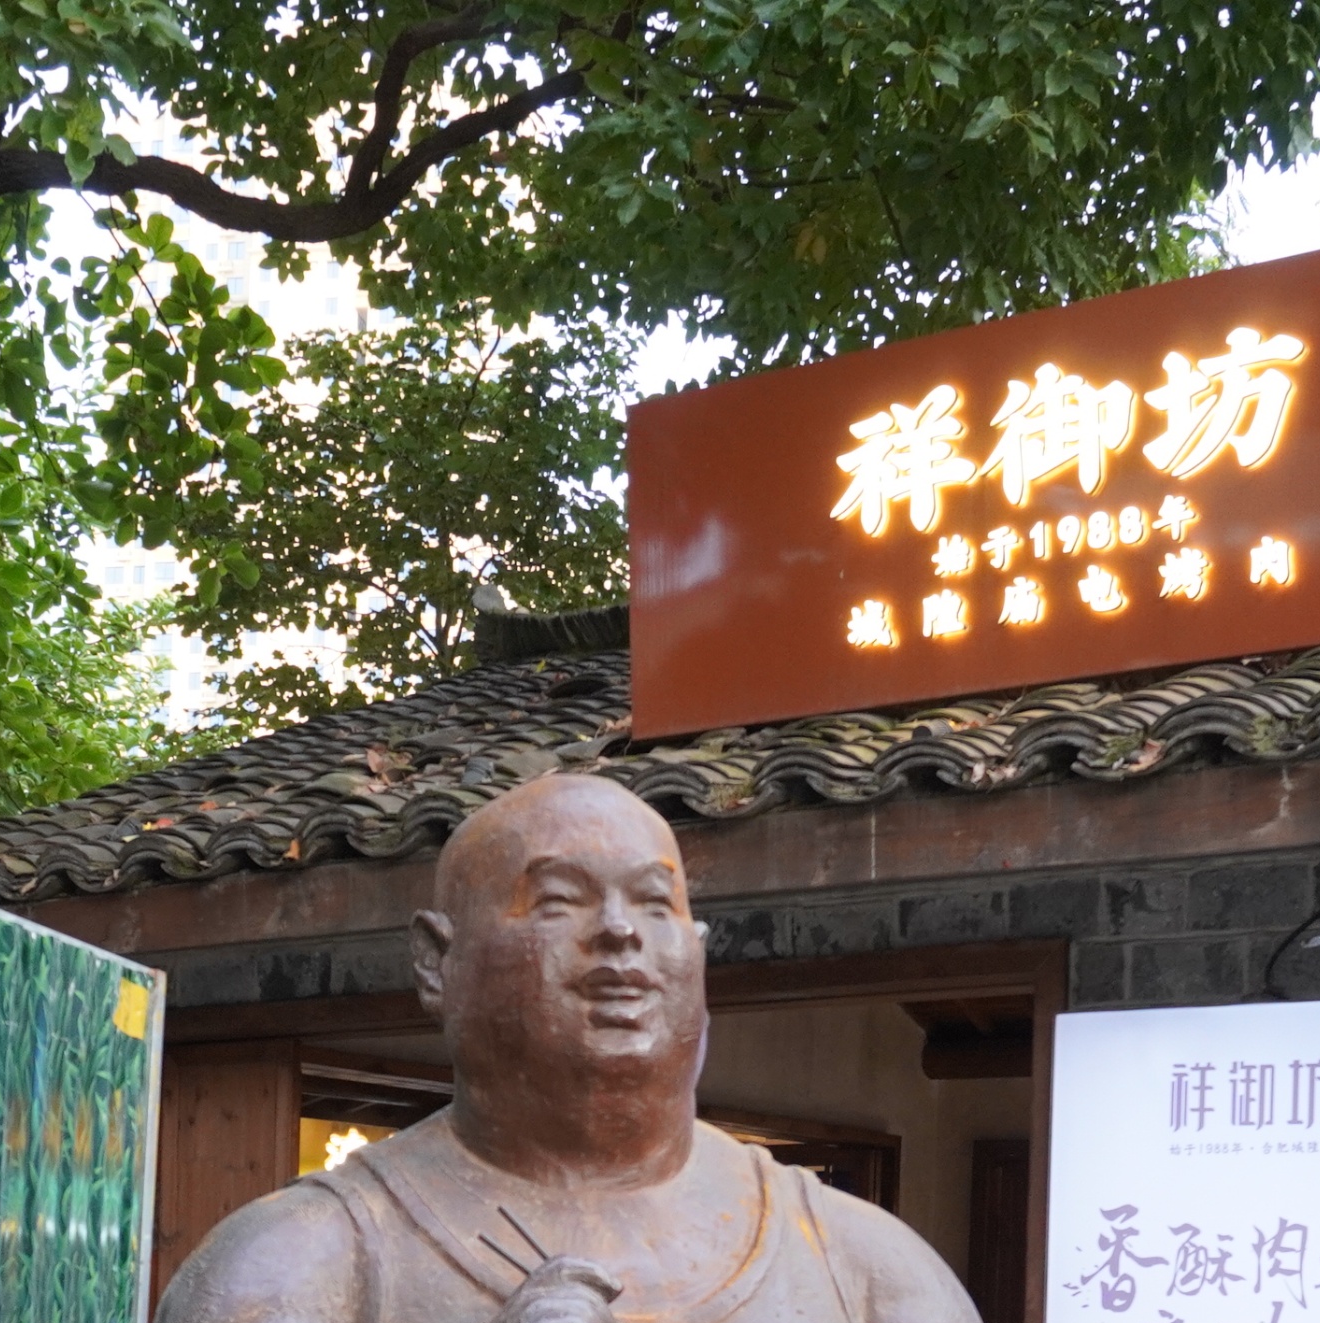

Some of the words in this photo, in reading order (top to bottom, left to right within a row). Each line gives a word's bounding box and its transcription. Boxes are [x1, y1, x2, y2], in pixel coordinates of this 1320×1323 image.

[830, 326, 1307, 535] 祥御坊
[846, 536, 1294, 648] 城隍庙电烤肉
[931, 495, 1199, 577] 始于1988年
